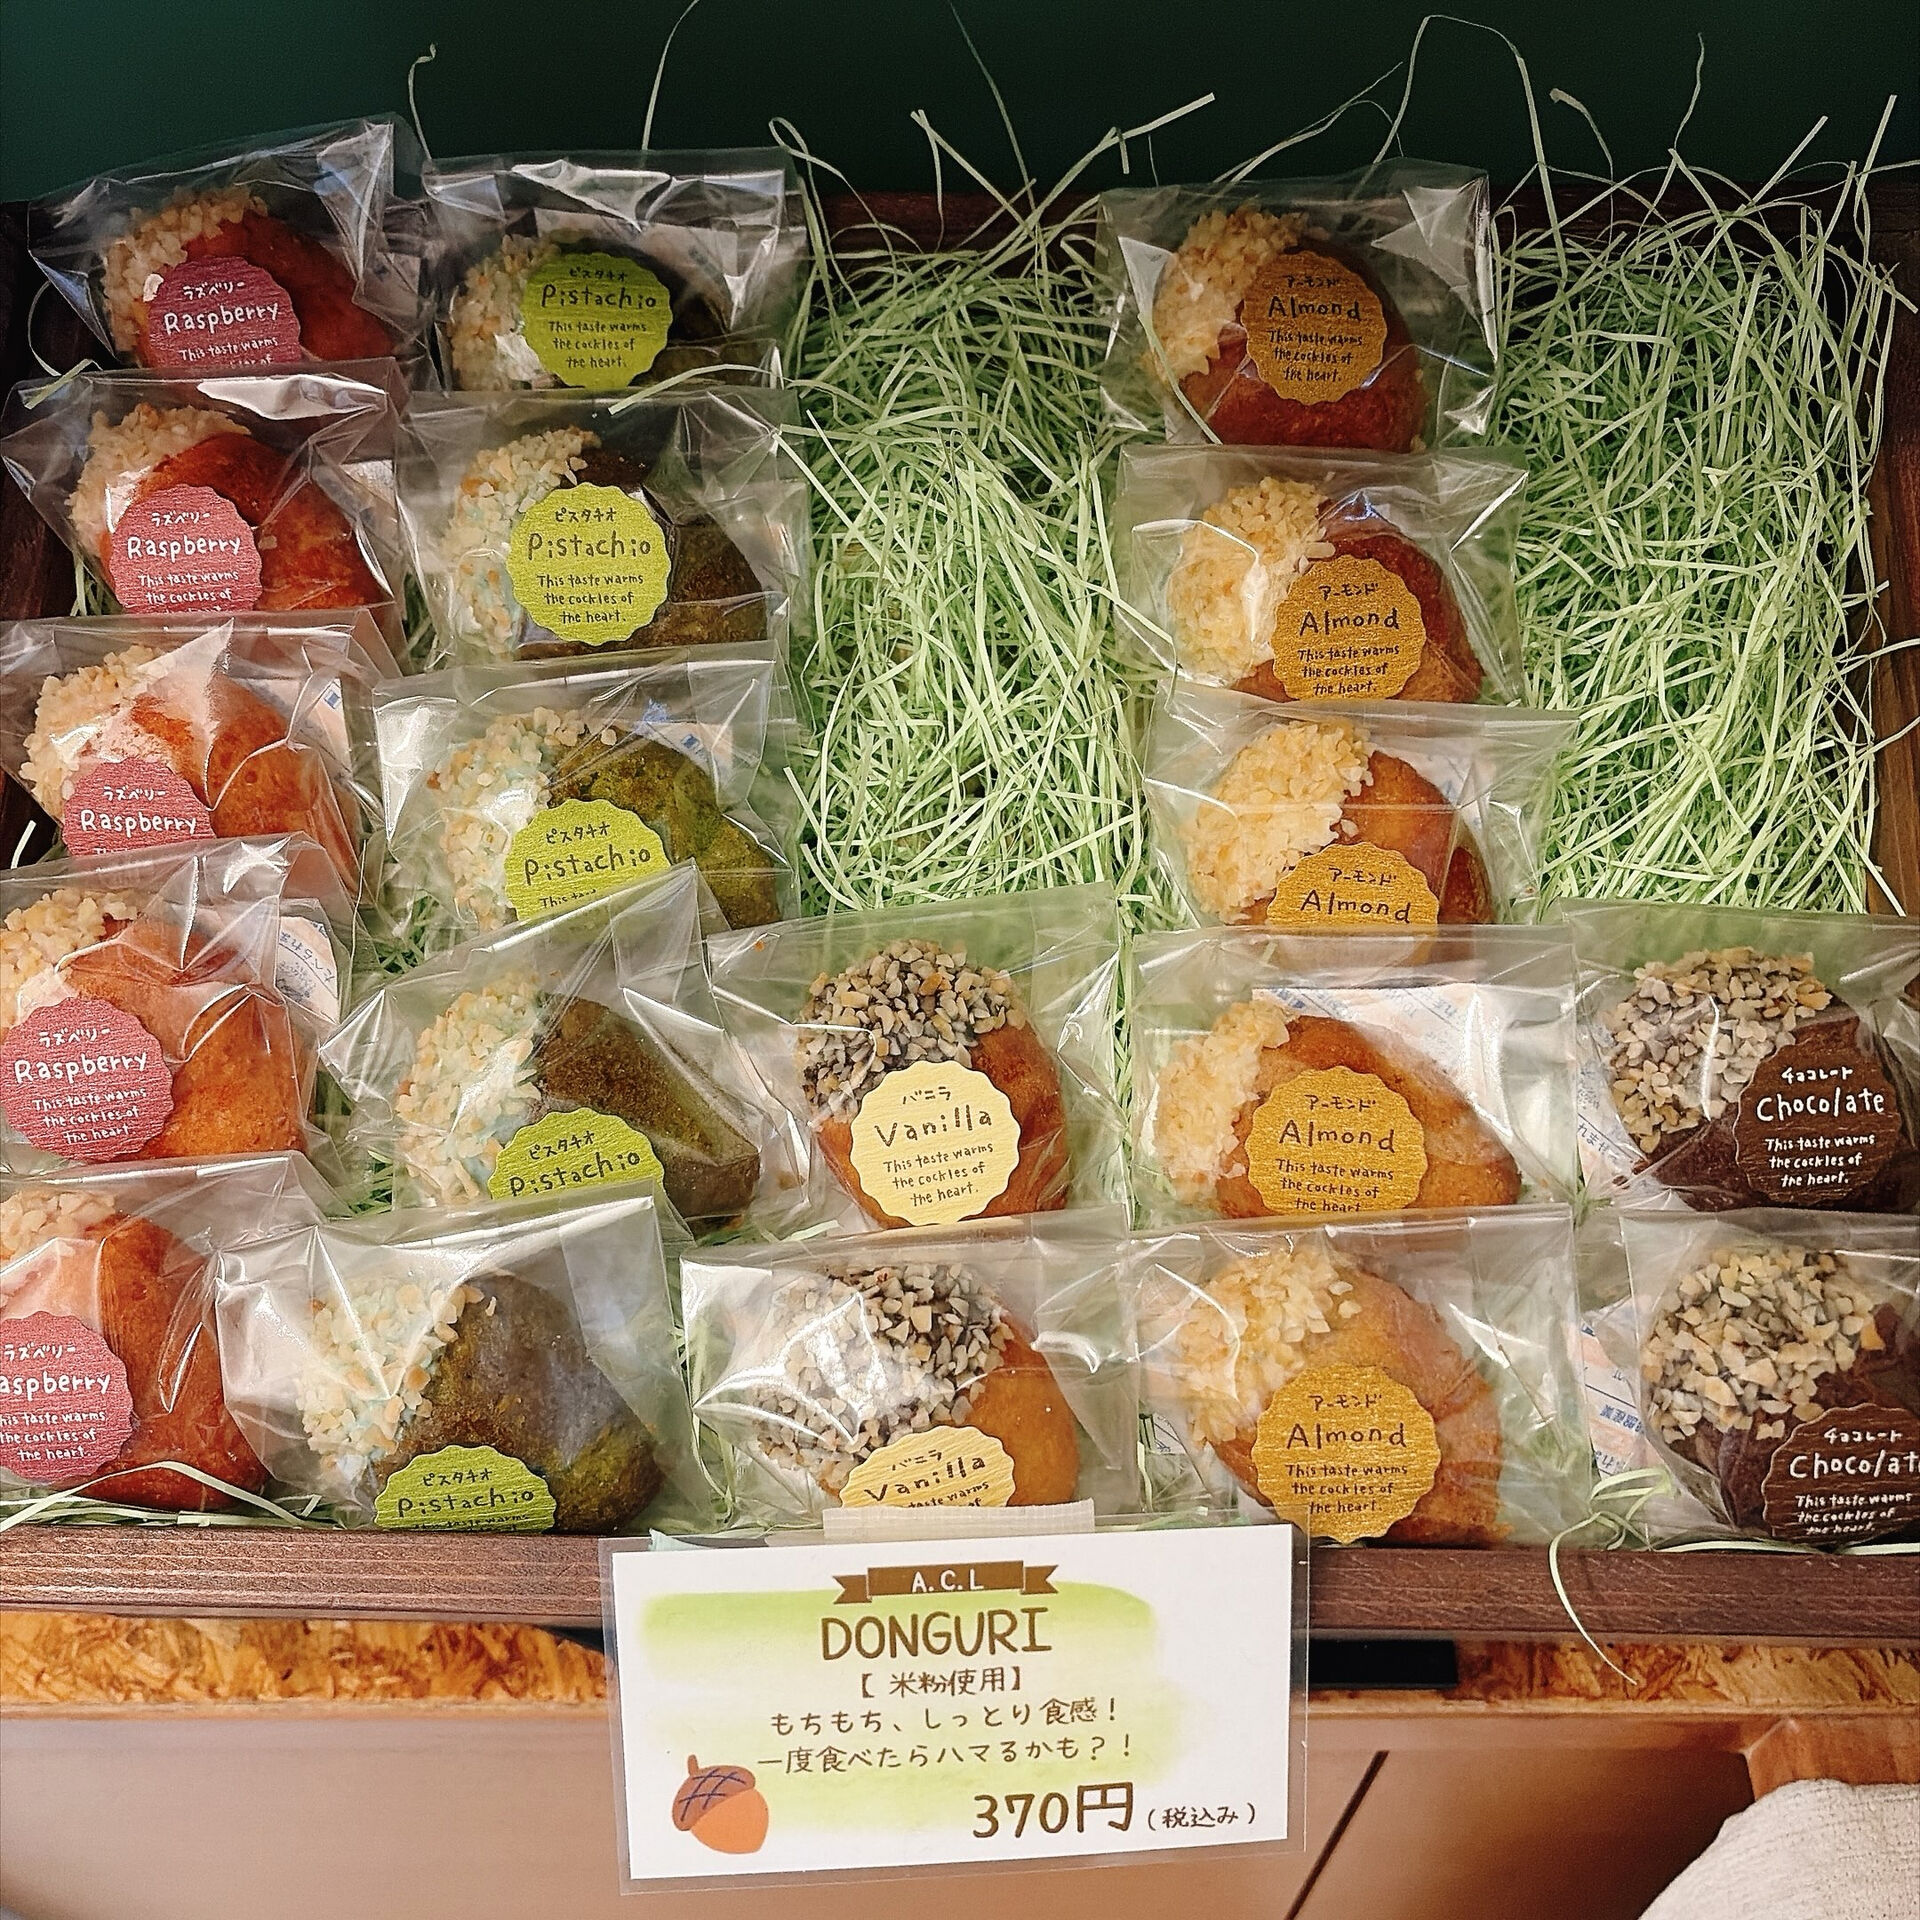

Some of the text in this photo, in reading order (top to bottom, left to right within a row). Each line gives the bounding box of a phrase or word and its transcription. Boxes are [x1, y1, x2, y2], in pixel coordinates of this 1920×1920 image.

[183, 281, 245, 300] ラズベリー
[541, 284, 656, 309] Pistachio
[1268, 296, 1360, 320] Almond
[164, 302, 278, 336] Raspberry
[151, 510, 210, 527] ラズベリー
[555, 507, 616, 522] ピスタチオ
[127, 535, 241, 563] Raspberry
[528, 530, 650, 561] Pistachio
[138, 571, 239, 588] This taste warms
[536, 574, 644, 588] This taste warms
[146, 588, 233, 605] the cockles of
[544, 591, 634, 605] the cockles of
[1318, 582, 1378, 600] アーモンド
[560, 611, 626, 624] the heart.
[1300, 607, 1399, 636] Almond
[1298, 645, 1399, 662] This taste warms
[1301, 662, 1388, 677] the cockles of
[1313, 680, 1377, 695] the heart.
[103, 785, 166, 801] ラズベリー
[80, 809, 196, 838] Raspberry
[546, 821, 610, 844] ピスタチオ
[524, 844, 650, 886] Pistachio
[1329, 867, 1396, 885] アーモンド
[1299, 889, 1410, 924] Almond
[39, 1028, 110, 1047] ラズベリー
[14, 1052, 147, 1084] Raspberry
[1781, 1066, 1853, 1085] チョコレート
[32, 1088, 146, 1111] This taste warms
[902, 1086, 951, 1105] バニラ
[1304, 1094, 1376, 1112] アーモンド
[1756, 1086, 1885, 1121] Chocolate
[43, 1105, 139, 1128] the cockles of
[874, 1104, 992, 1147] Vanilla
[63, 1131, 88, 1144] the
[529, 1131, 594, 1159] ピスタチオ
[1279, 1119, 1395, 1153] Almond
[1765, 1134, 1876, 1152] This taste warms
[883, 1143, 993, 1173] This taste warms
[1769, 1152, 1862, 1168] the cockles of
[510, 1152, 640, 1196] Pistachio
[892, 1161, 985, 1190] the cockles of
[1275, 1158, 1394, 1180] This taste warms
[1280, 1177, 1379, 1199] the cockles of
[1781, 1171, 1849, 1187] the heart.
[910, 1181, 979, 1207] the heart.
[1295, 1198, 1317, 1210] the
[4, 1342, 76, 1360] ラズベリー
[0, 1370, 110, 1401] aspberry
[1308, 1394, 1382, 1411] アーモンド
[0, 1412, 106, 1426] his taste warms
[24, 1431, 79, 1443] cockles
[82, 1428, 96, 1441] of
[1287, 1422, 1407, 1450] Almond
[1823, 1427, 1902, 1444] チョコレート
[17, 1446, 91, 1461] the heart.
[891, 1449, 942, 1471] バニラ
[1285, 1464, 1408, 1479] This taste warms
[1790, 1449, 1920, 1479] Chocolat
[423, 1468, 492, 1486] ピスタチオ
[863, 1457, 985, 1502] Vanilla
[947, 1481, 989, 1501] warms
[1292, 1482, 1394, 1495] the cockles of
[398, 1487, 534, 1518] Pistachio
[1309, 1500, 1382, 1514] the heart.
[1795, 1492, 1912, 1508] This taste warms
[1798, 1507, 1896, 1522] the cockles of
[911, 1569, 984, 1593] A.C.L
[821, 1607, 1053, 1660] DONGURI
[771, 1697, 1116, 1736] もちもち、しっとり食感！
[757, 1734, 1130, 1774] 一度食べたらハマるかも？！
[972, 1781, 1133, 1838] 370円
